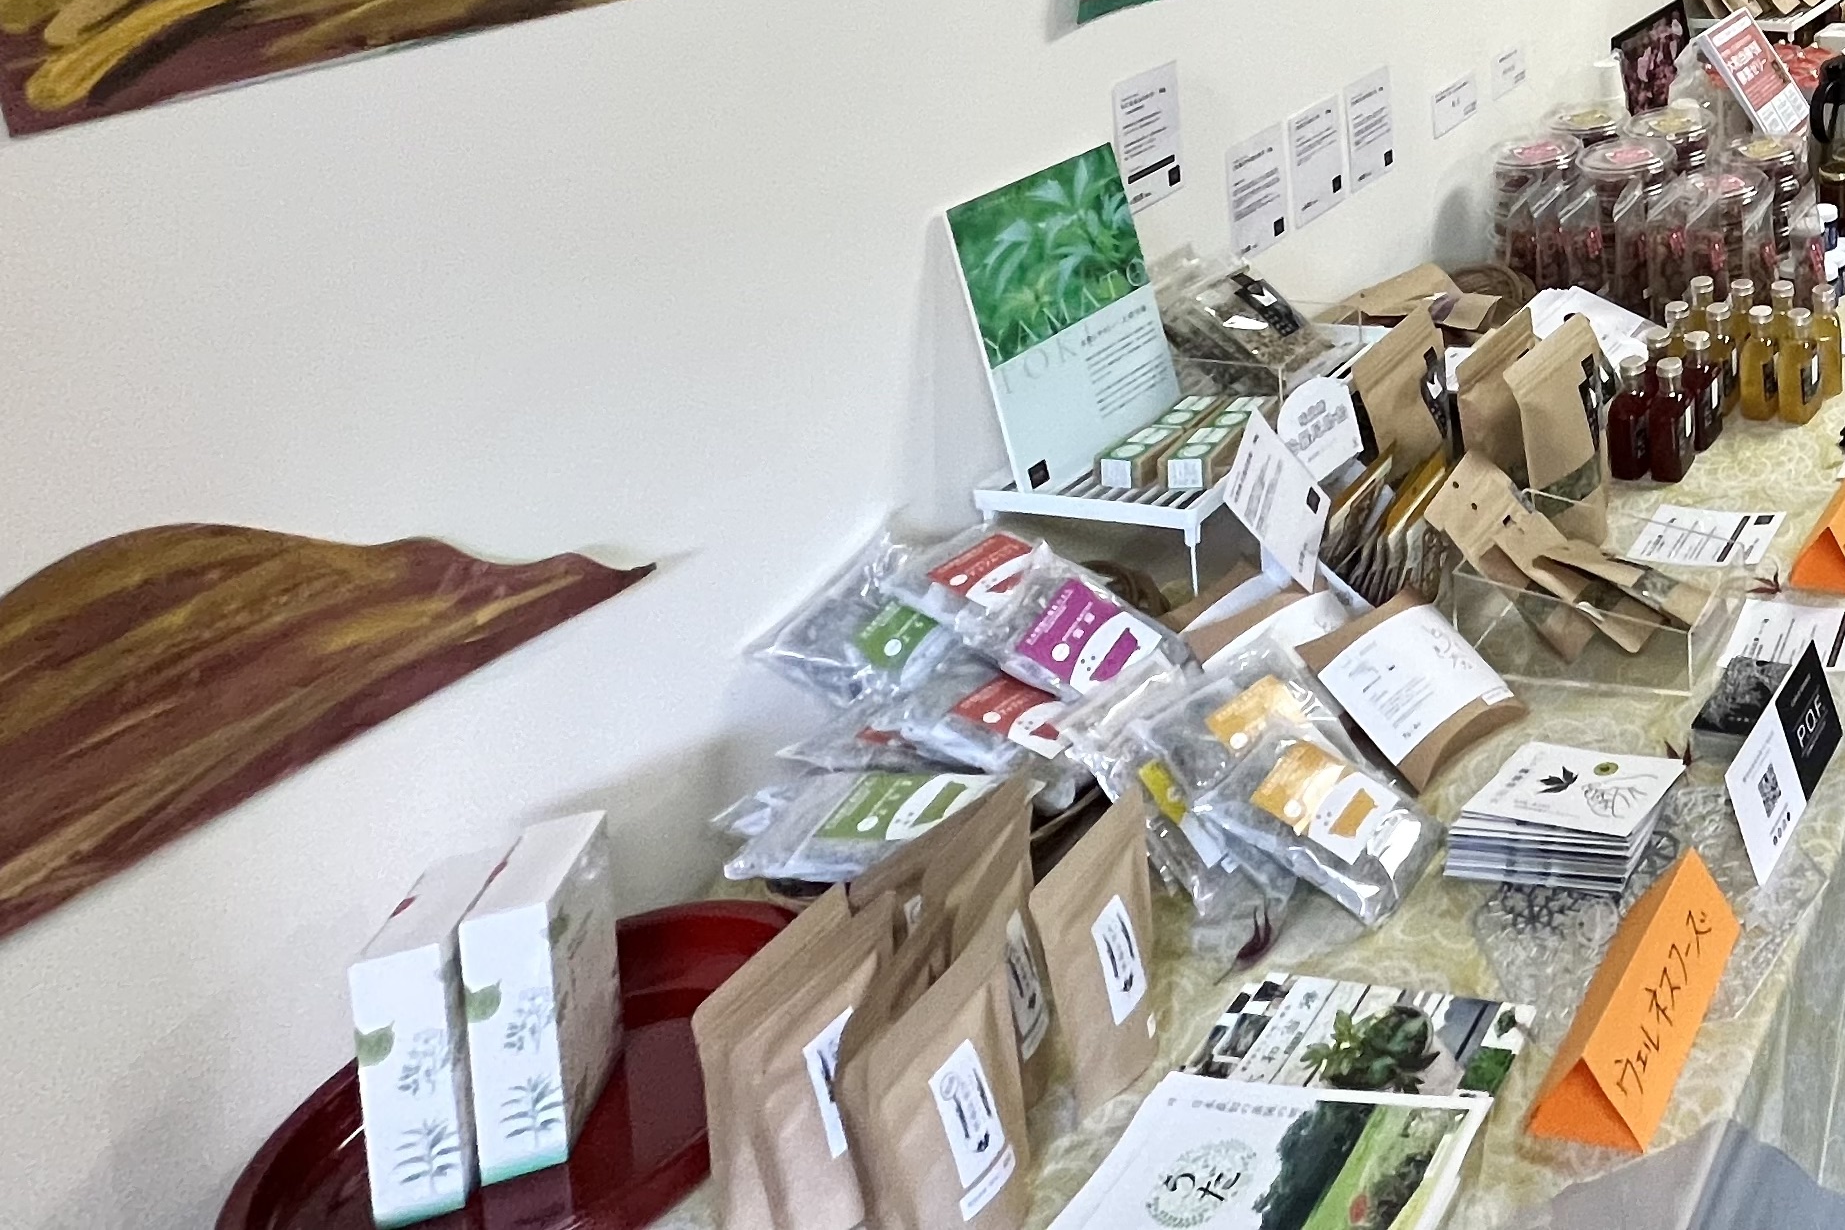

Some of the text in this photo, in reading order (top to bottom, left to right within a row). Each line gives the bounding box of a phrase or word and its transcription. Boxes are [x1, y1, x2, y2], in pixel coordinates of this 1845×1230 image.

[1614, 910, 1712, 1096] ウェルネスフーズ
